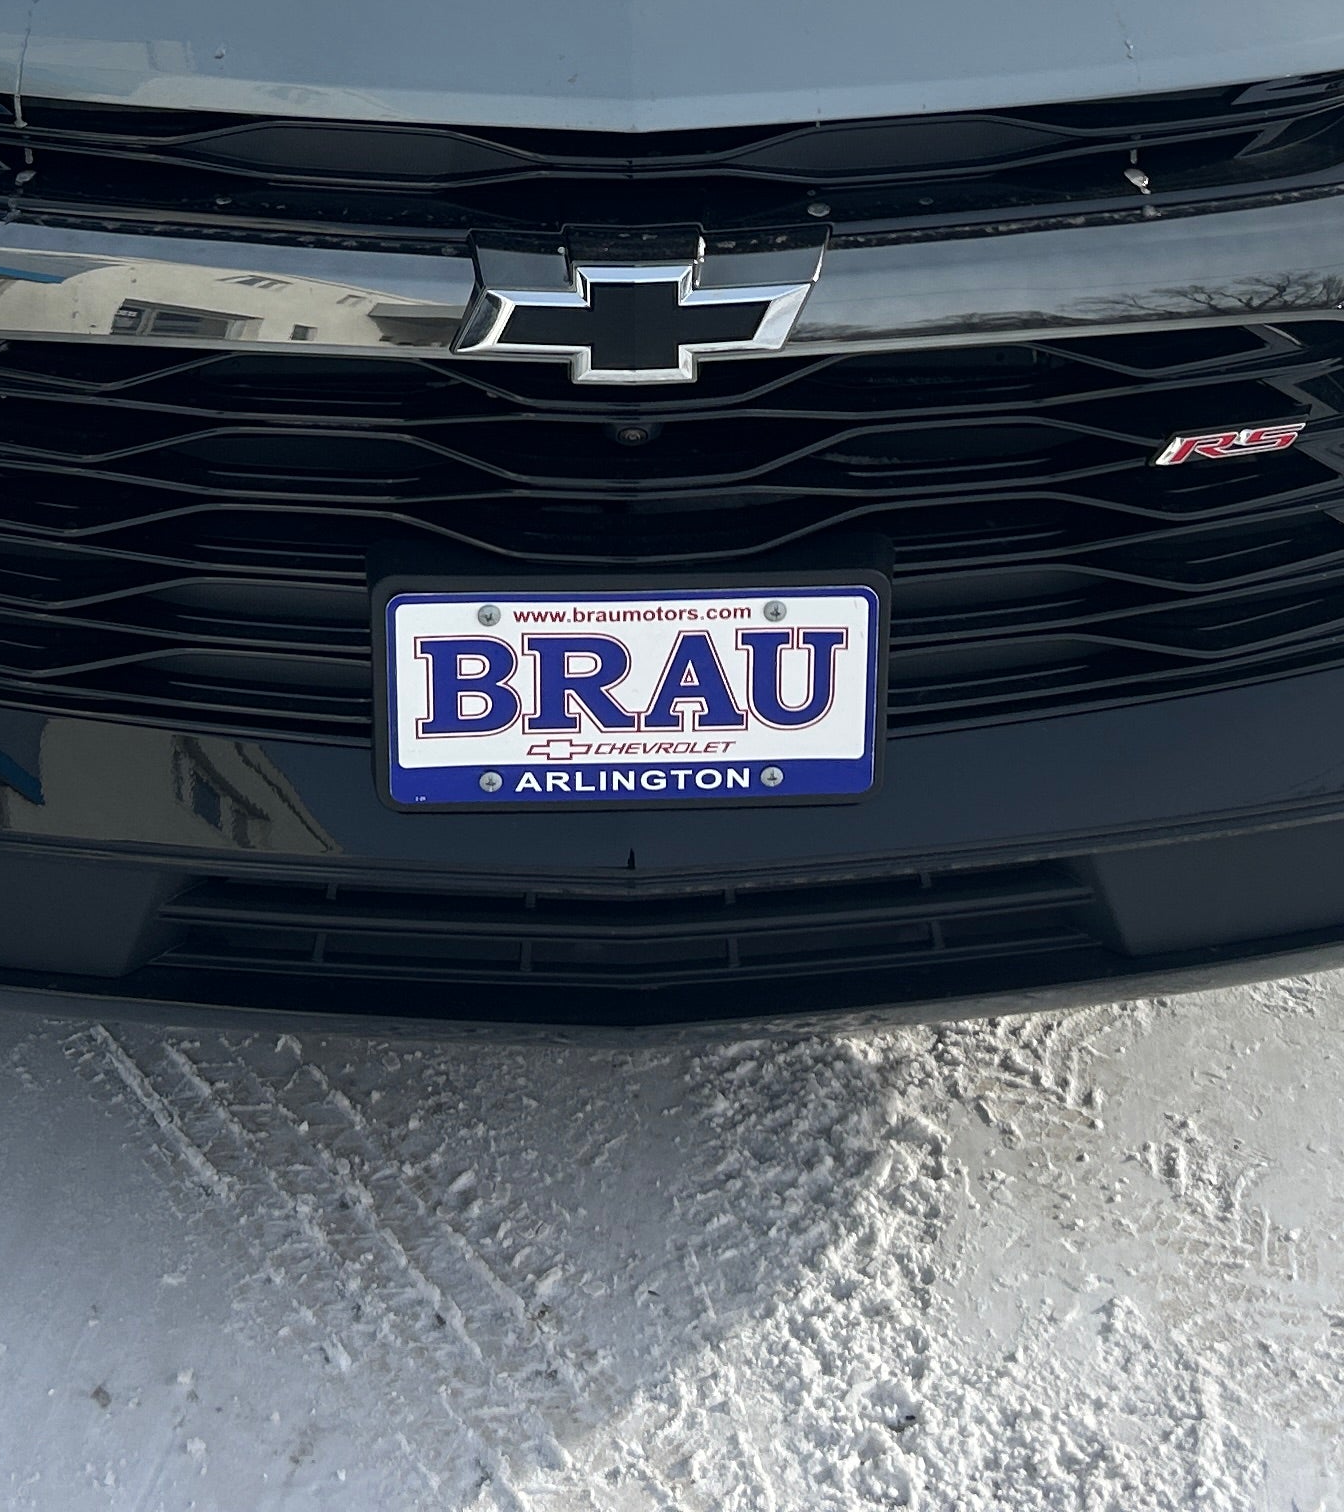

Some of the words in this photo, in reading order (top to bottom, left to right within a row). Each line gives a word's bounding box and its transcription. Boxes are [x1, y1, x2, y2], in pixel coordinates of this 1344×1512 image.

[1155, 422, 1308, 466] RS
[513, 604, 752, 624] www.braumotors.com
[413, 626, 849, 739] BRAU
[593, 740, 737, 756] CHEVROLET
[515, 768, 751, 793] ARLINGTON
